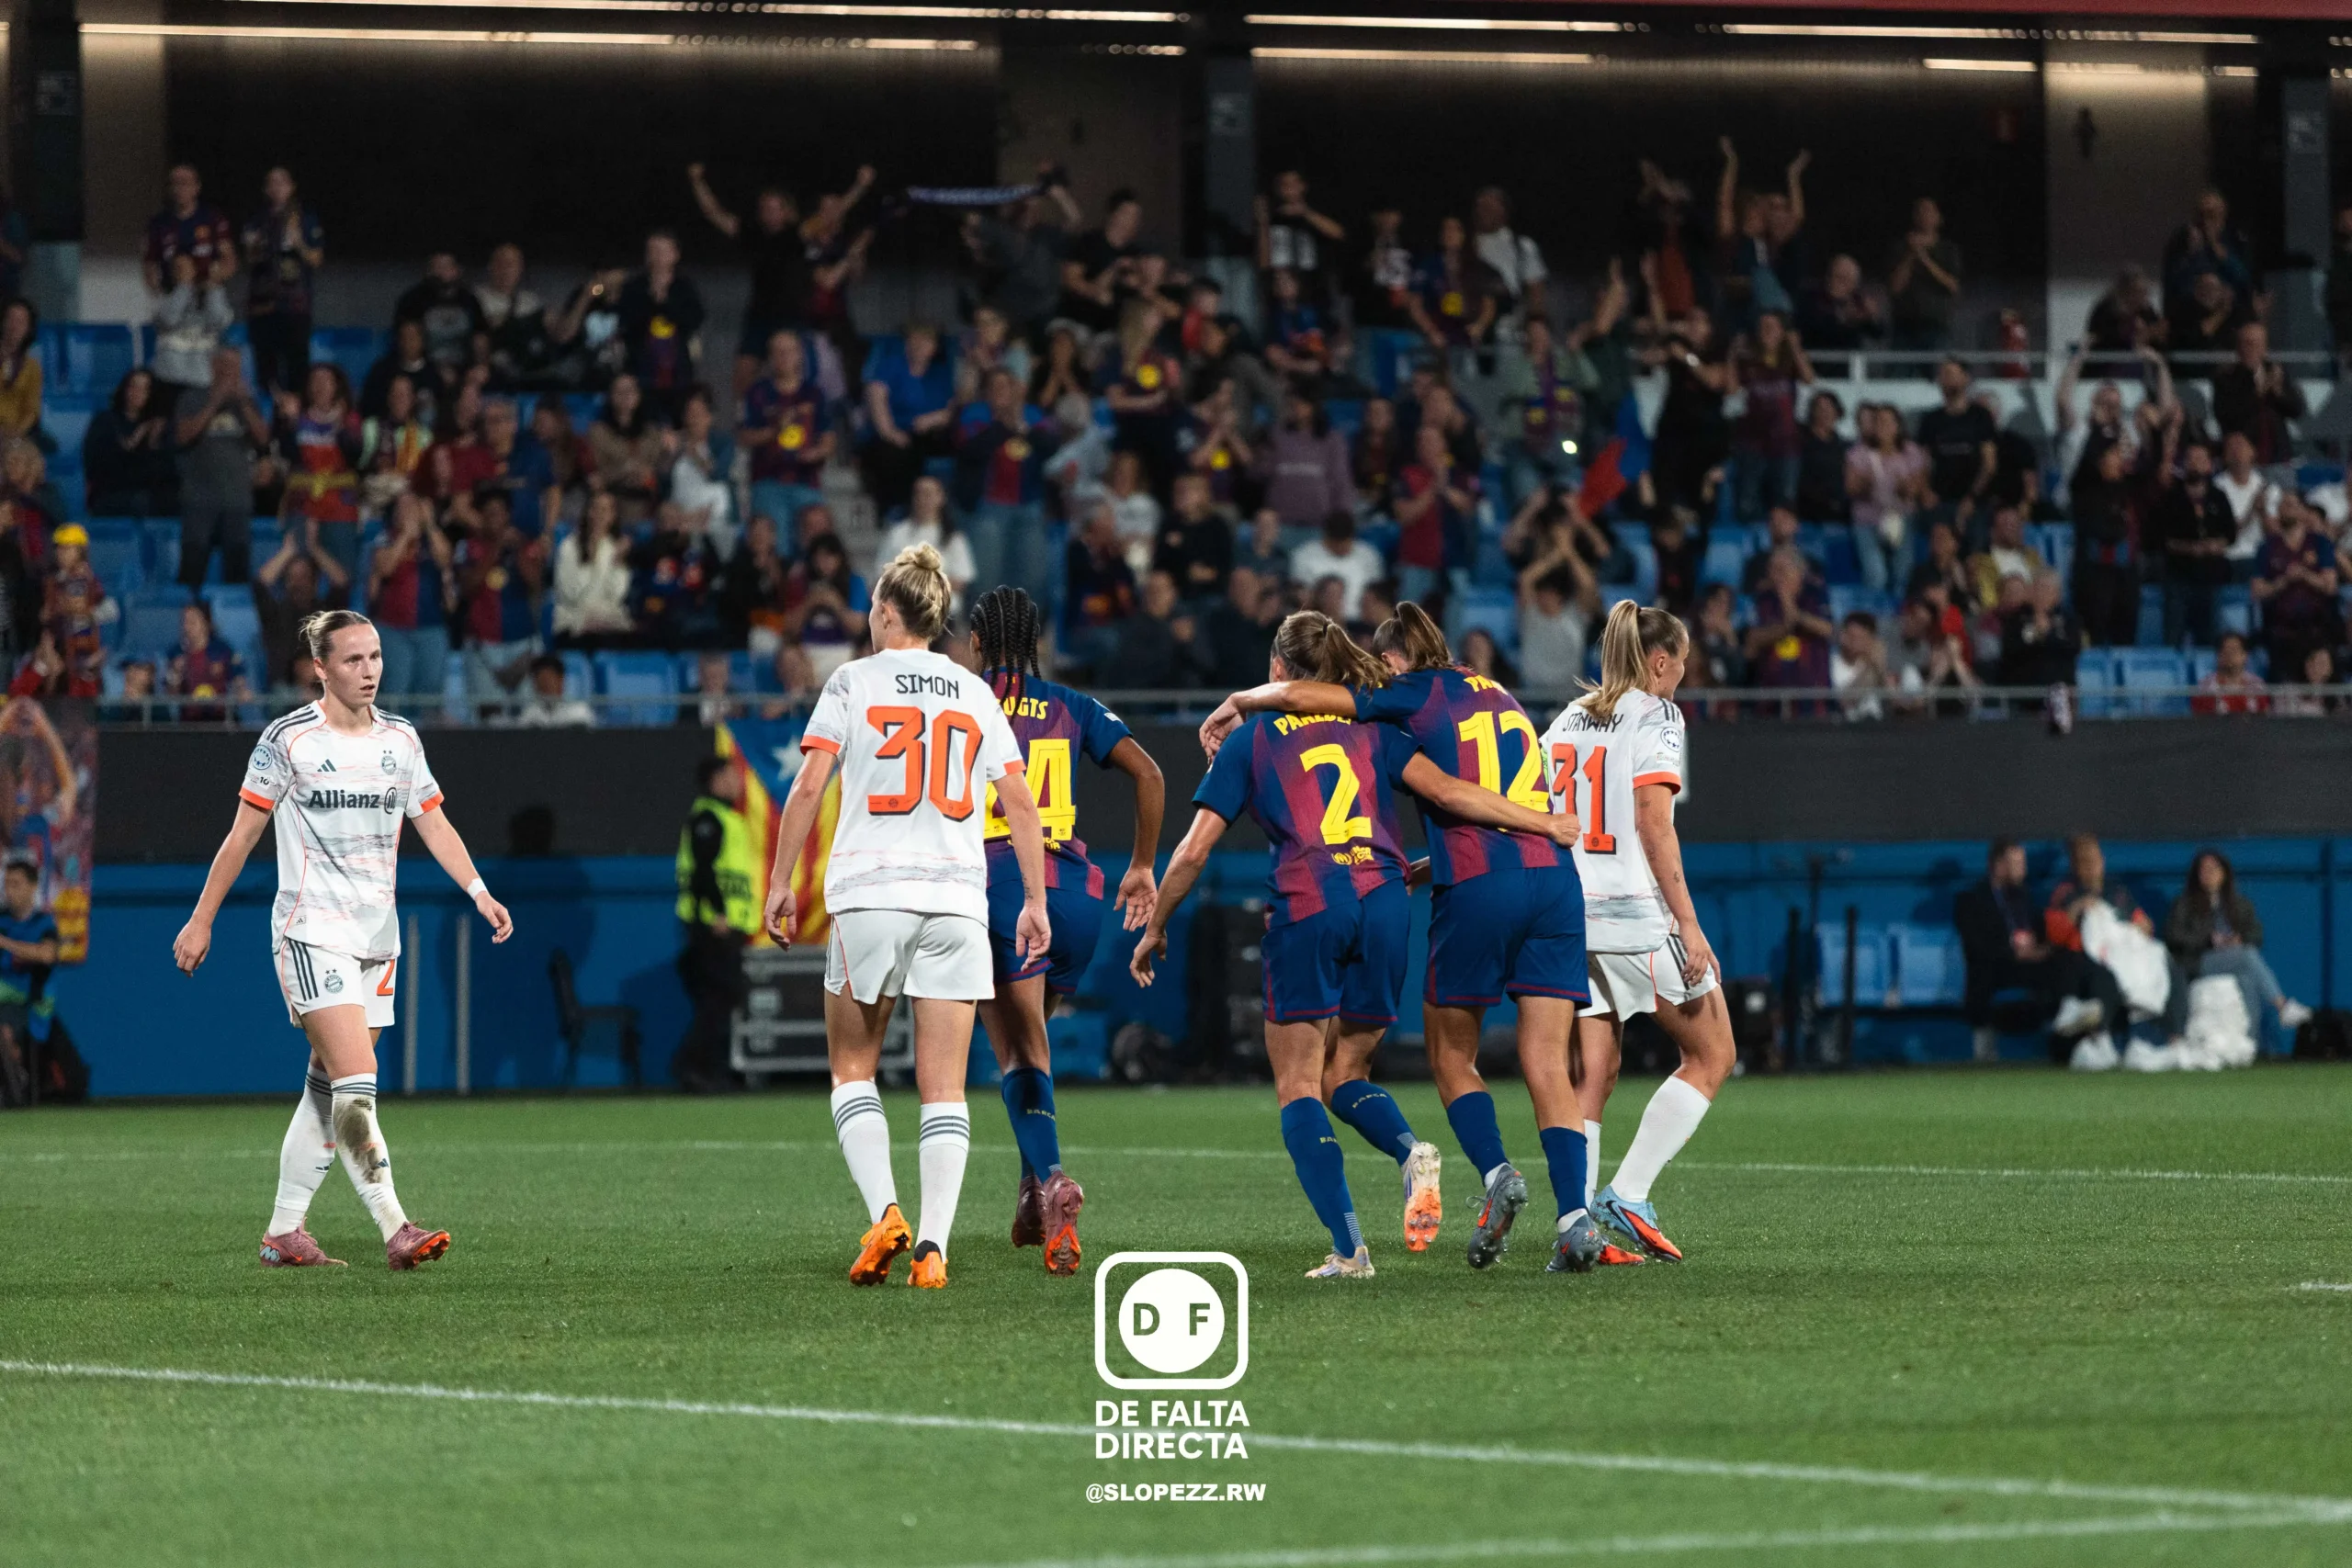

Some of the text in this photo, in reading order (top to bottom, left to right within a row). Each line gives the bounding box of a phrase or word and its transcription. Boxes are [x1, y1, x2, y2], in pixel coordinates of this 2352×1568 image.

[895, 674, 959, 699] SIMON
[308, 789, 380, 808] Allianz
[866, 705, 984, 822] 30
[1299, 743, 1373, 845] 2
[1458, 710, 1550, 813] 12
[1551, 742, 1616, 855] 31
